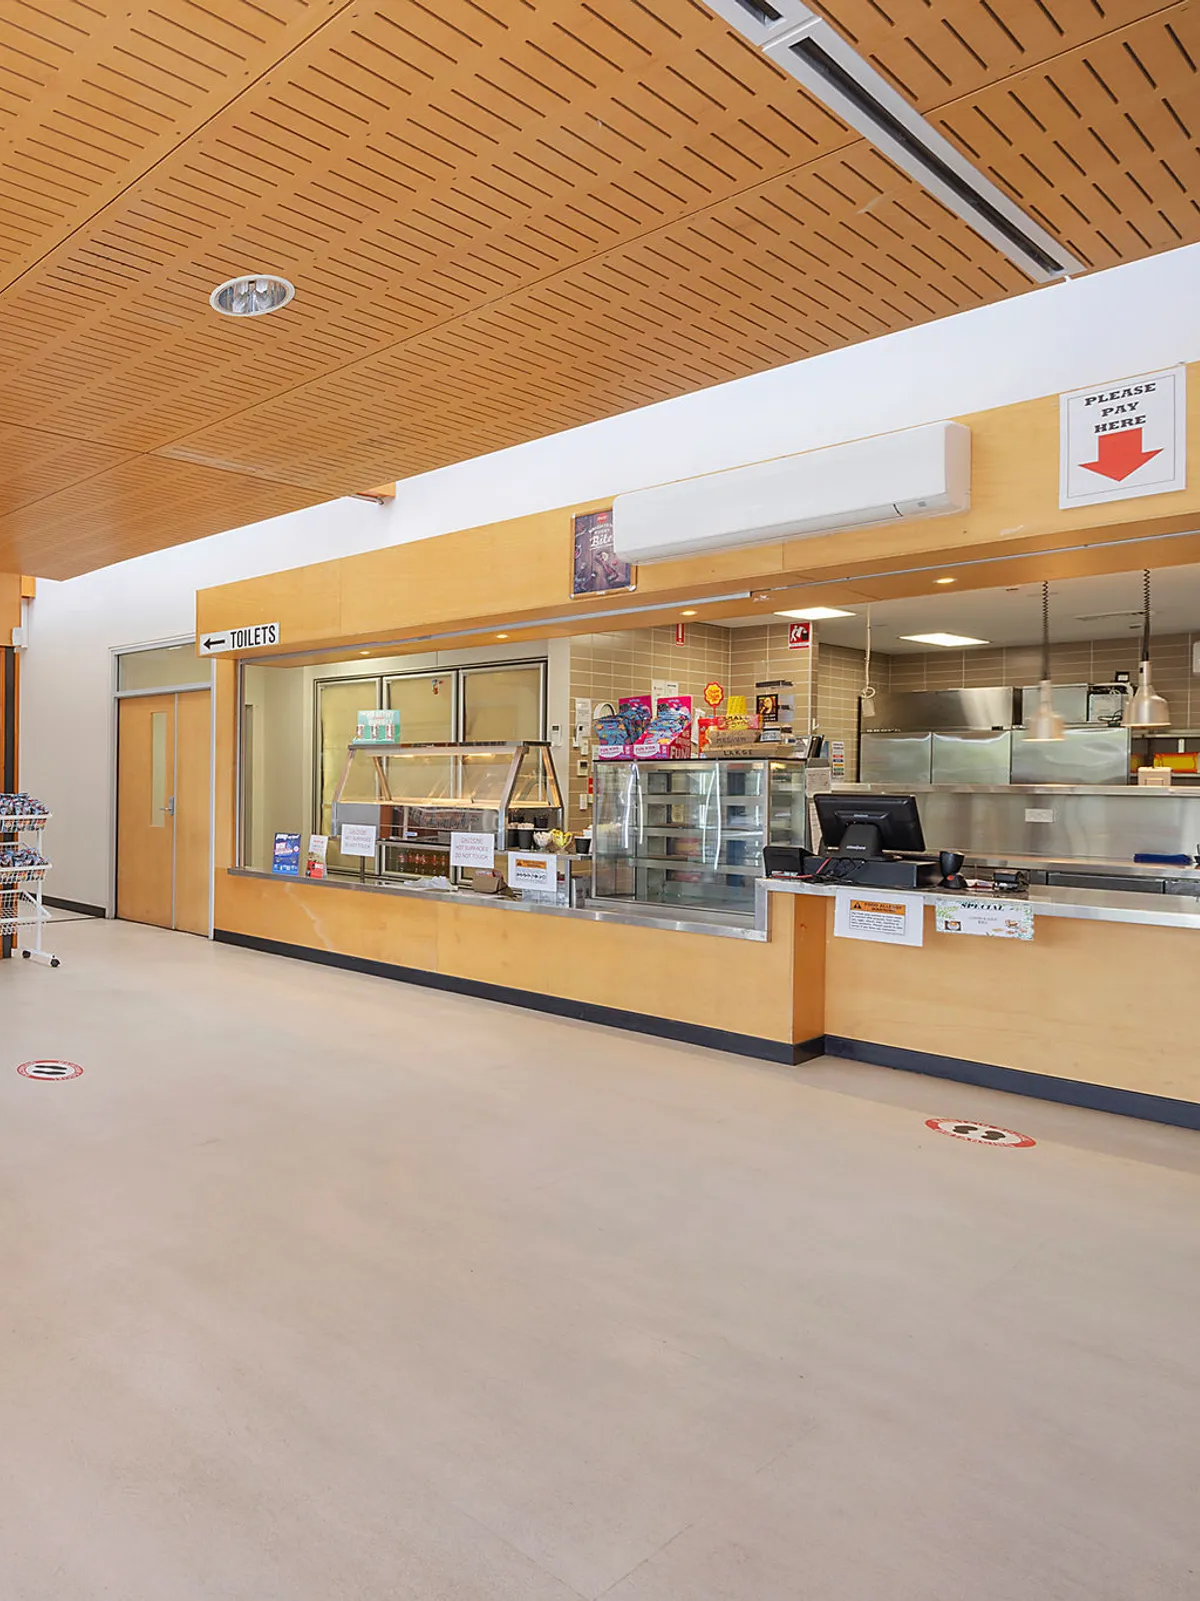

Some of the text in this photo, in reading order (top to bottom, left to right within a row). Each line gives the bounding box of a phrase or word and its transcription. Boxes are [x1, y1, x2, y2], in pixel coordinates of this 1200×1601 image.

[1084, 383, 1156, 406] PLEASE
[1101, 401, 1139, 417] PAY
[1094, 415, 1146, 433] HERE
[230, 625, 276, 648] TOILETS
[961, 903, 1004, 911] SPECIAL
